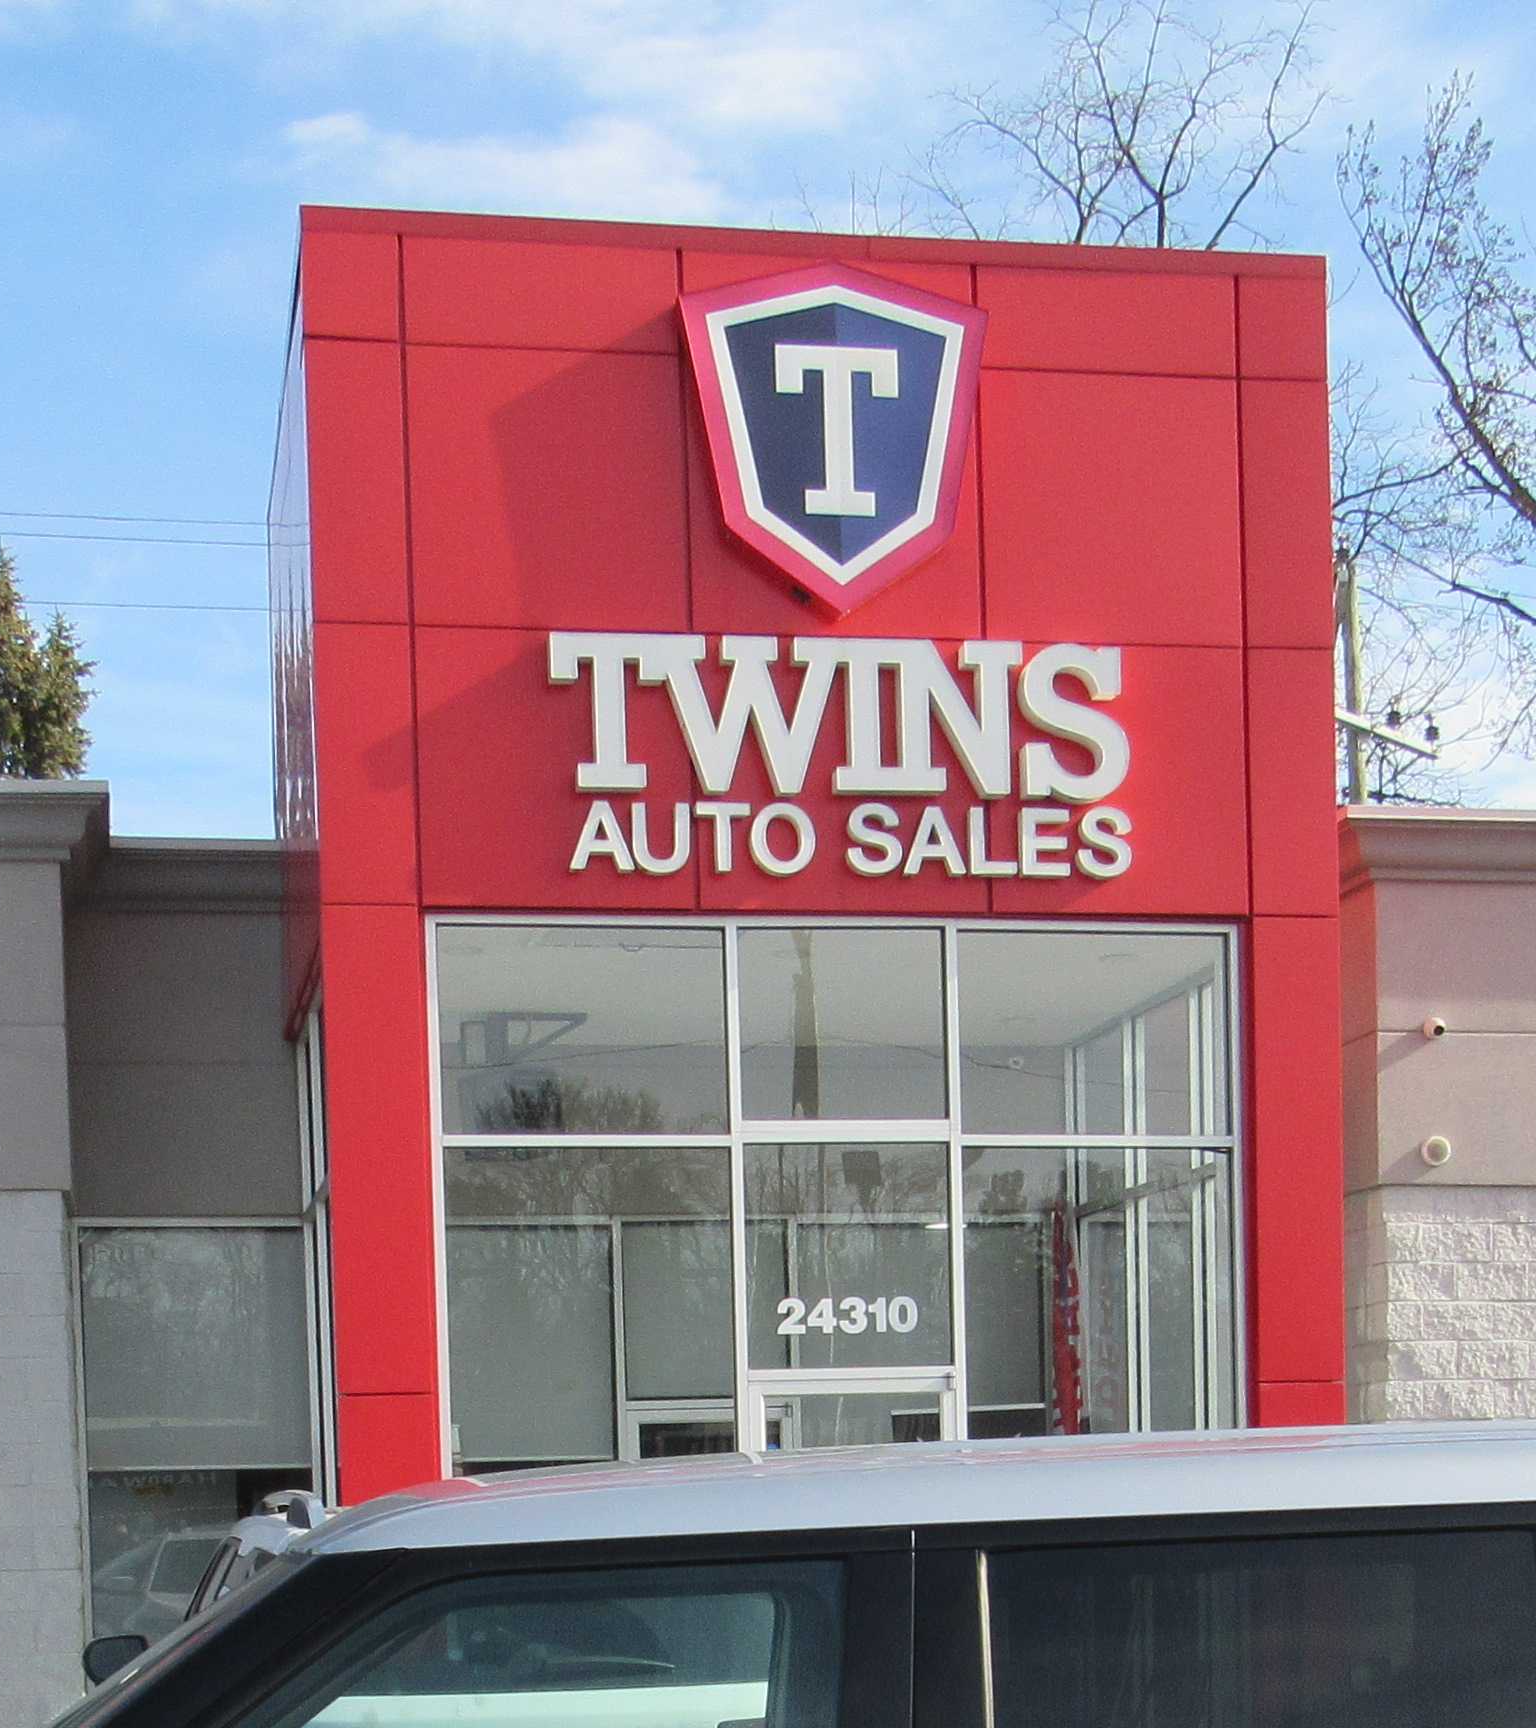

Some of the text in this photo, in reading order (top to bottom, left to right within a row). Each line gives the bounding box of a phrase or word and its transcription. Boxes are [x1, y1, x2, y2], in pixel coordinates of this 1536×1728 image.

[774, 343, 899, 517] T
[548, 631, 1131, 801] TWINS
[569, 800, 1133, 878] AUTO SALES
[776, 1295, 919, 1335] 24310
